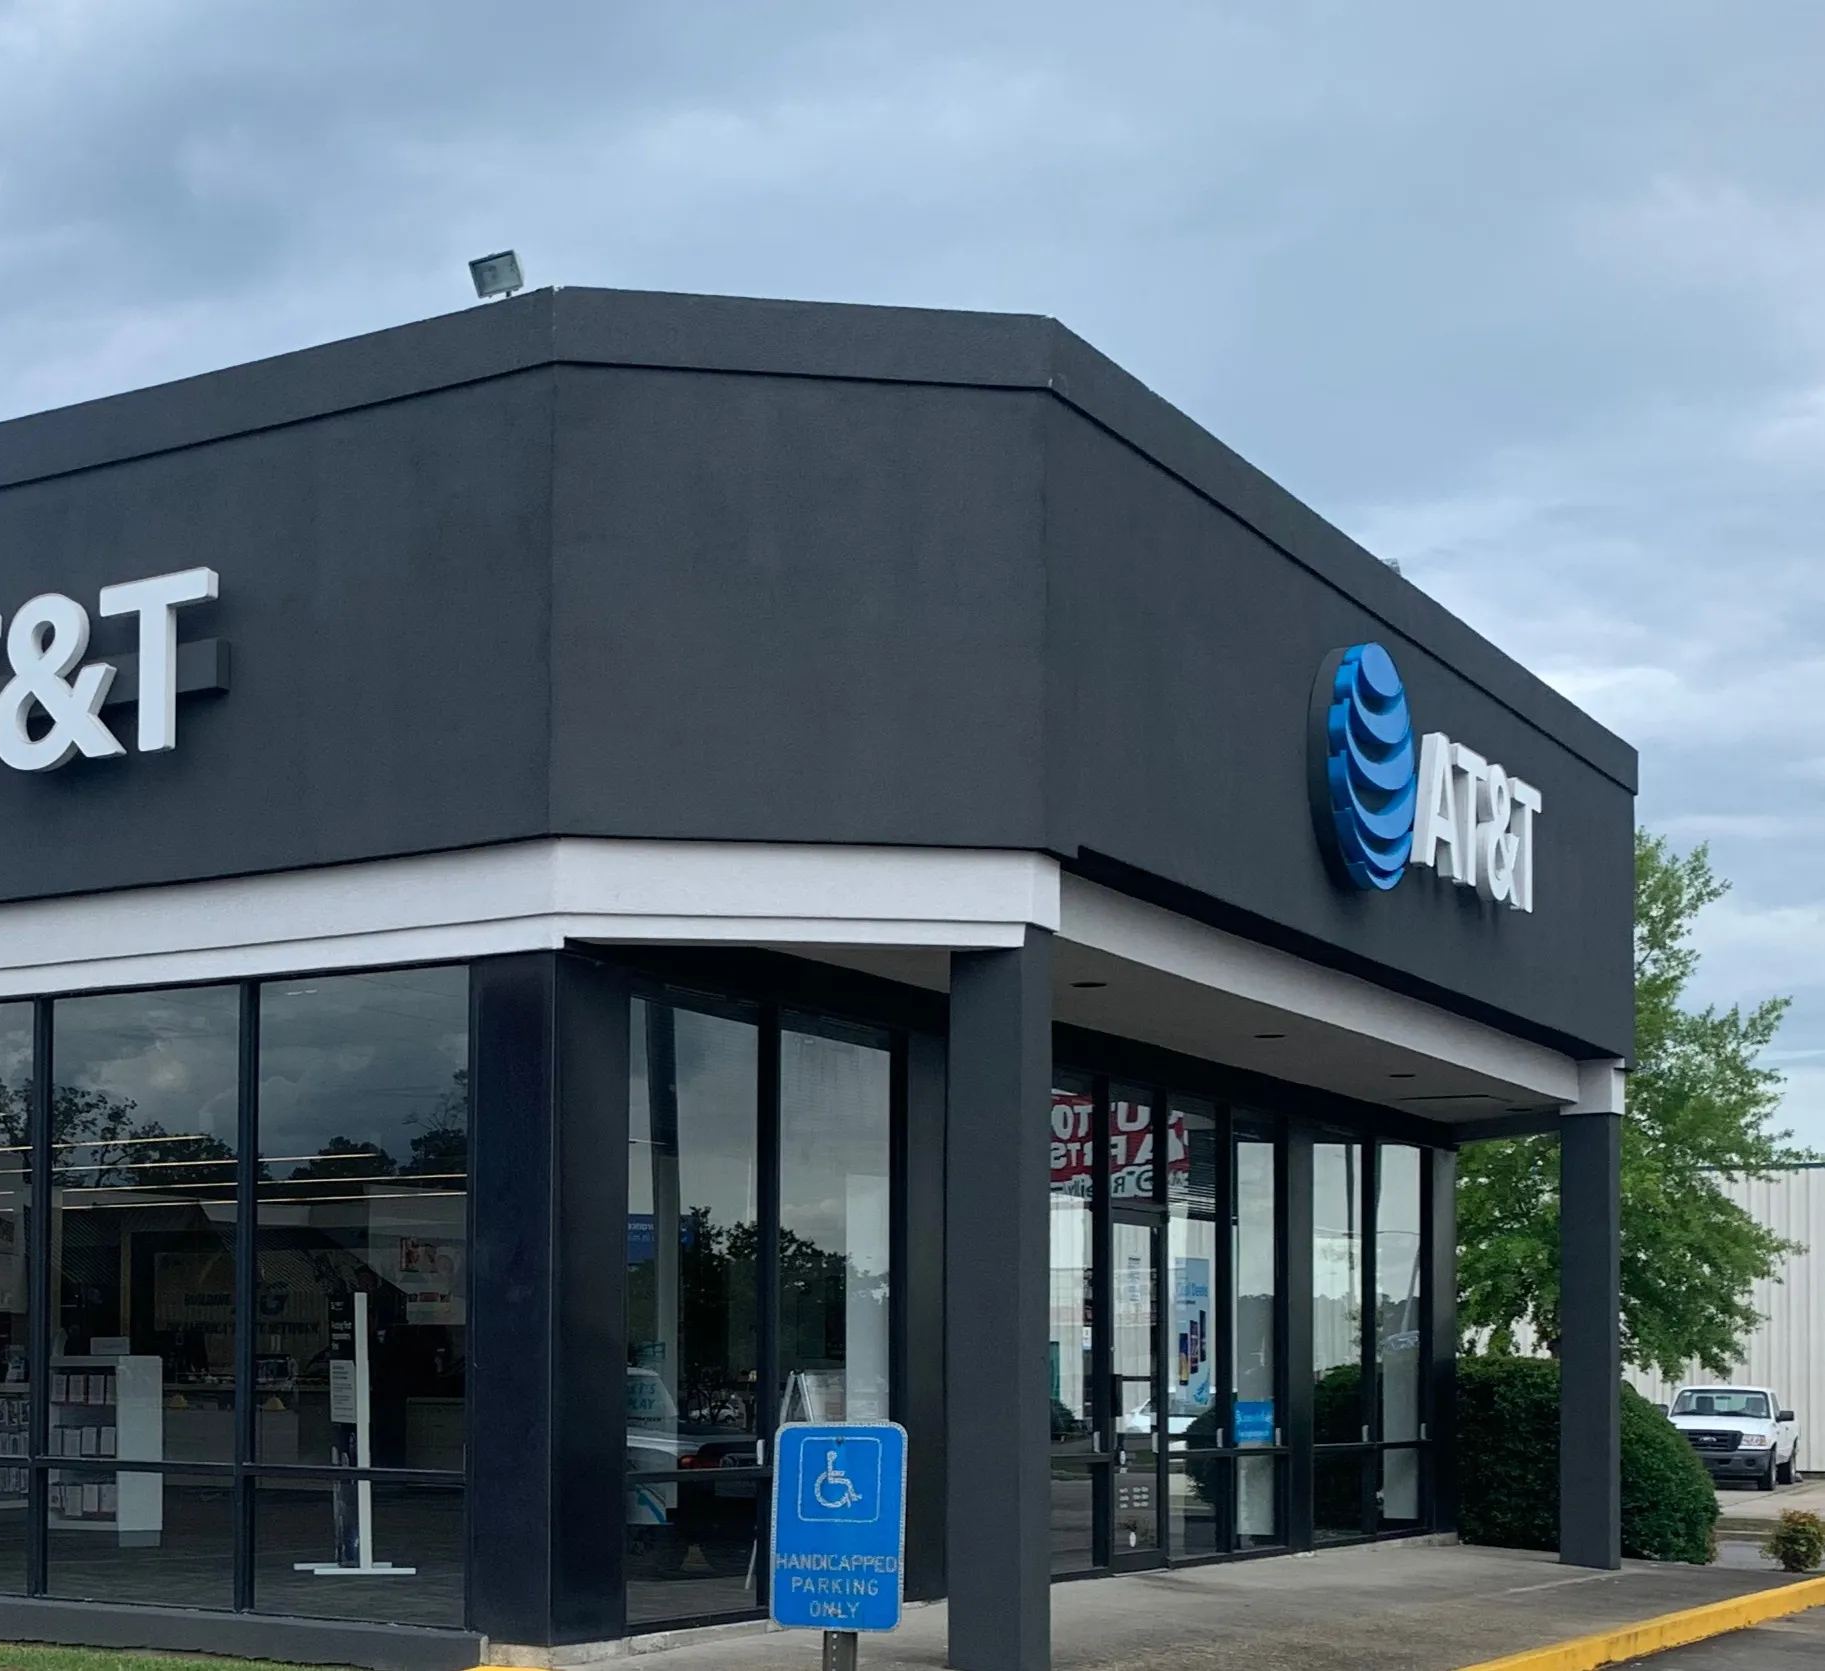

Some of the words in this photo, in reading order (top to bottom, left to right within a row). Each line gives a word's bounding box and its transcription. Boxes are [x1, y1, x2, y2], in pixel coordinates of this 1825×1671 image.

[1409, 731, 1542, 913] AT&T
[776, 1552, 899, 1573] HANDICAPPED
[791, 1576, 879, 1596] PARKING
[809, 1601, 860, 1618] ONLY
